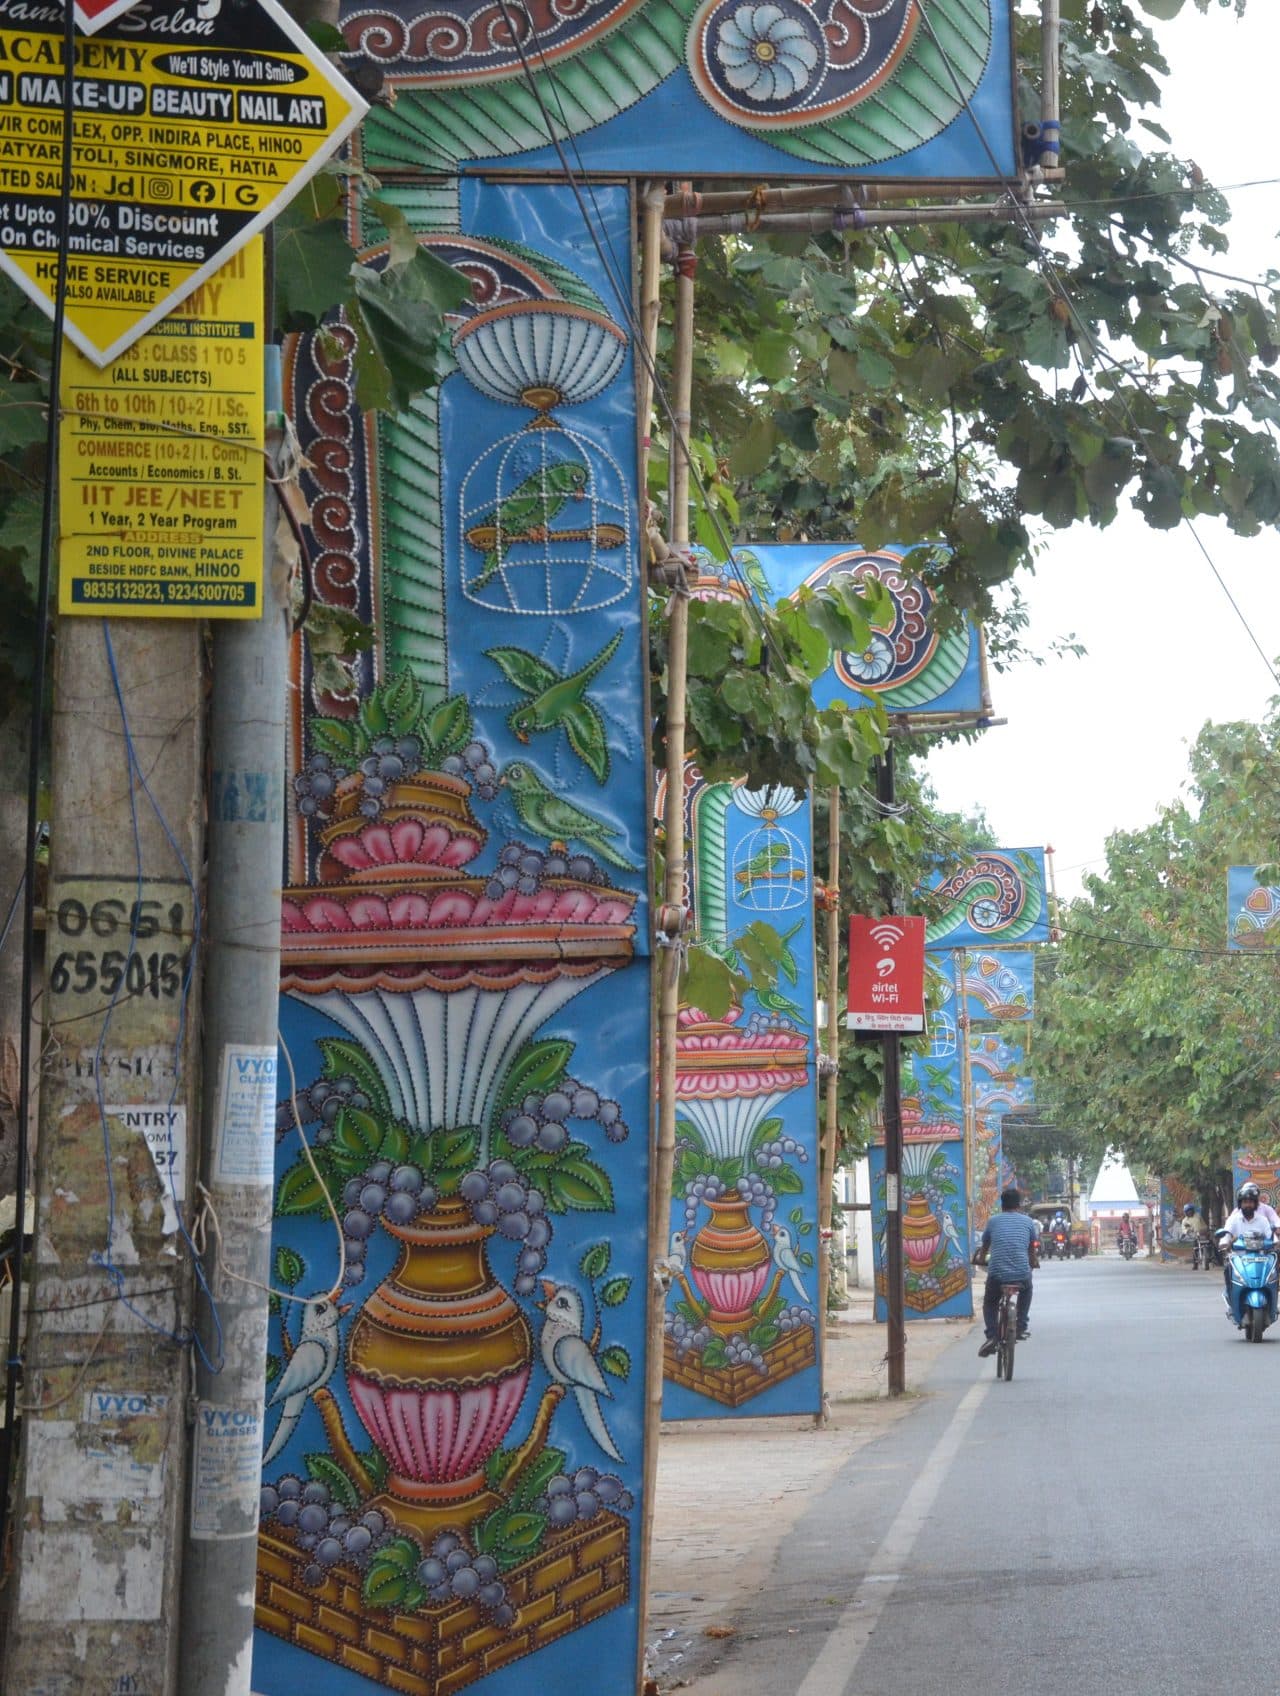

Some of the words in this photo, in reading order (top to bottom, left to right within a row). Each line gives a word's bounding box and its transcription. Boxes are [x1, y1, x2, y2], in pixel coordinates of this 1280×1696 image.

[117, 4, 215, 36] Salon
[169, 55, 197, 75] We'll
[200, 57, 230, 81] Style
[232, 59, 263, 80] You'll
[265, 63, 295, 82] Smile
[152, 87, 232, 118] BEAUTY
[240, 95, 284, 123] NAIL
[288, 99, 323, 125] ART
[27, 117, 106, 142] COMLEX,
[111, 124, 143, 142] OPP.
[149, 127, 201, 147] INDIRA
[206, 131, 255, 153] PLACE,
[259, 136, 303, 154] HINOO
[0, 141, 62, 160] ATYAR
[73, 147, 119, 167] TOLI,
[125, 151, 224, 174] SINGMORE,
[230, 160, 278, 177] HATIA
[104, 175, 135, 197] Jd
[15, 204, 56, 226] Upto
[118, 206, 219, 237] Discount
[1, 226, 27, 246] On
[32, 229, 120, 253] Chmical
[125, 236, 206, 260] Services
[94, 267, 170, 287] SERVICE
[64, 284, 93, 300] ALSO
[96, 287, 156, 304] AVAILABLE
[190, 322, 241, 336] INSTITUTE
[152, 343, 197, 363] CLASS
[215, 346, 234, 365] TO
[237, 346, 246, 365] 5
[112, 367, 139, 384] (ALL
[143, 368, 212, 387] SUBJECTS)
[76, 392, 100, 412] 6th
[104, 393, 119, 413] to
[125, 394, 156, 414] 10th
[77, 439, 151, 458] COMMERCE
[88, 463, 138, 478] Accounts
[147, 465, 205, 480] Economics
[82, 484, 115, 506] IIT
[124, 486, 163, 508] JEE
[101, 512, 133, 528] Year,
[137, 513, 145, 527] 2
[150, 513, 178, 527] Year
[183, 514, 237, 531] Program
[124, 532, 200, 544] ADDRESS
[86, 545, 110, 558] 2ND
[113, 546, 154, 560] FLOOR,
[158, 547, 197, 559] DIVINE
[200, 548, 244, 560] PALACE
[89, 564, 126, 576] BESIDE
[129, 565, 156, 577] HDFC
[160, 565, 192, 578] BANK,
[195, 563, 240, 578] HINOO
[168, 583, 245, 601] 9234300705
[58, 897, 184, 941] 0651
[872, 982, 898, 992] airtel
[872, 993, 899, 1003] Wi-Fi
[235, 1057, 277, 1074] VYO
